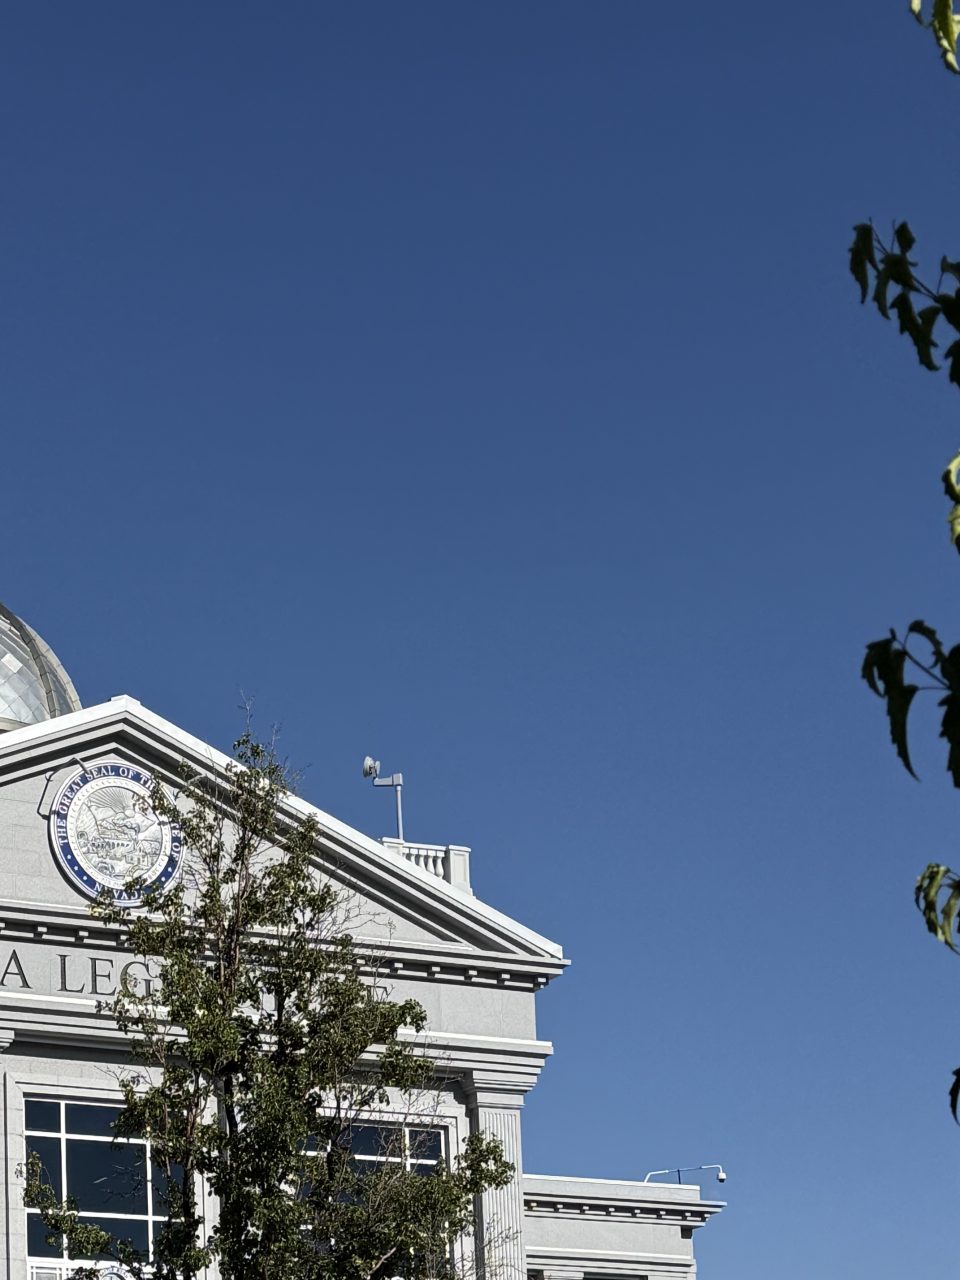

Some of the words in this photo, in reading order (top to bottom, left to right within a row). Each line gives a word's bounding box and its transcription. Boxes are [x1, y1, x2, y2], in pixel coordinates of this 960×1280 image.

[85, 765, 115, 781] SEAL
[119, 767, 137, 779] OF
[58, 776, 84, 815] GREAT
[57, 818, 69, 846] THE
